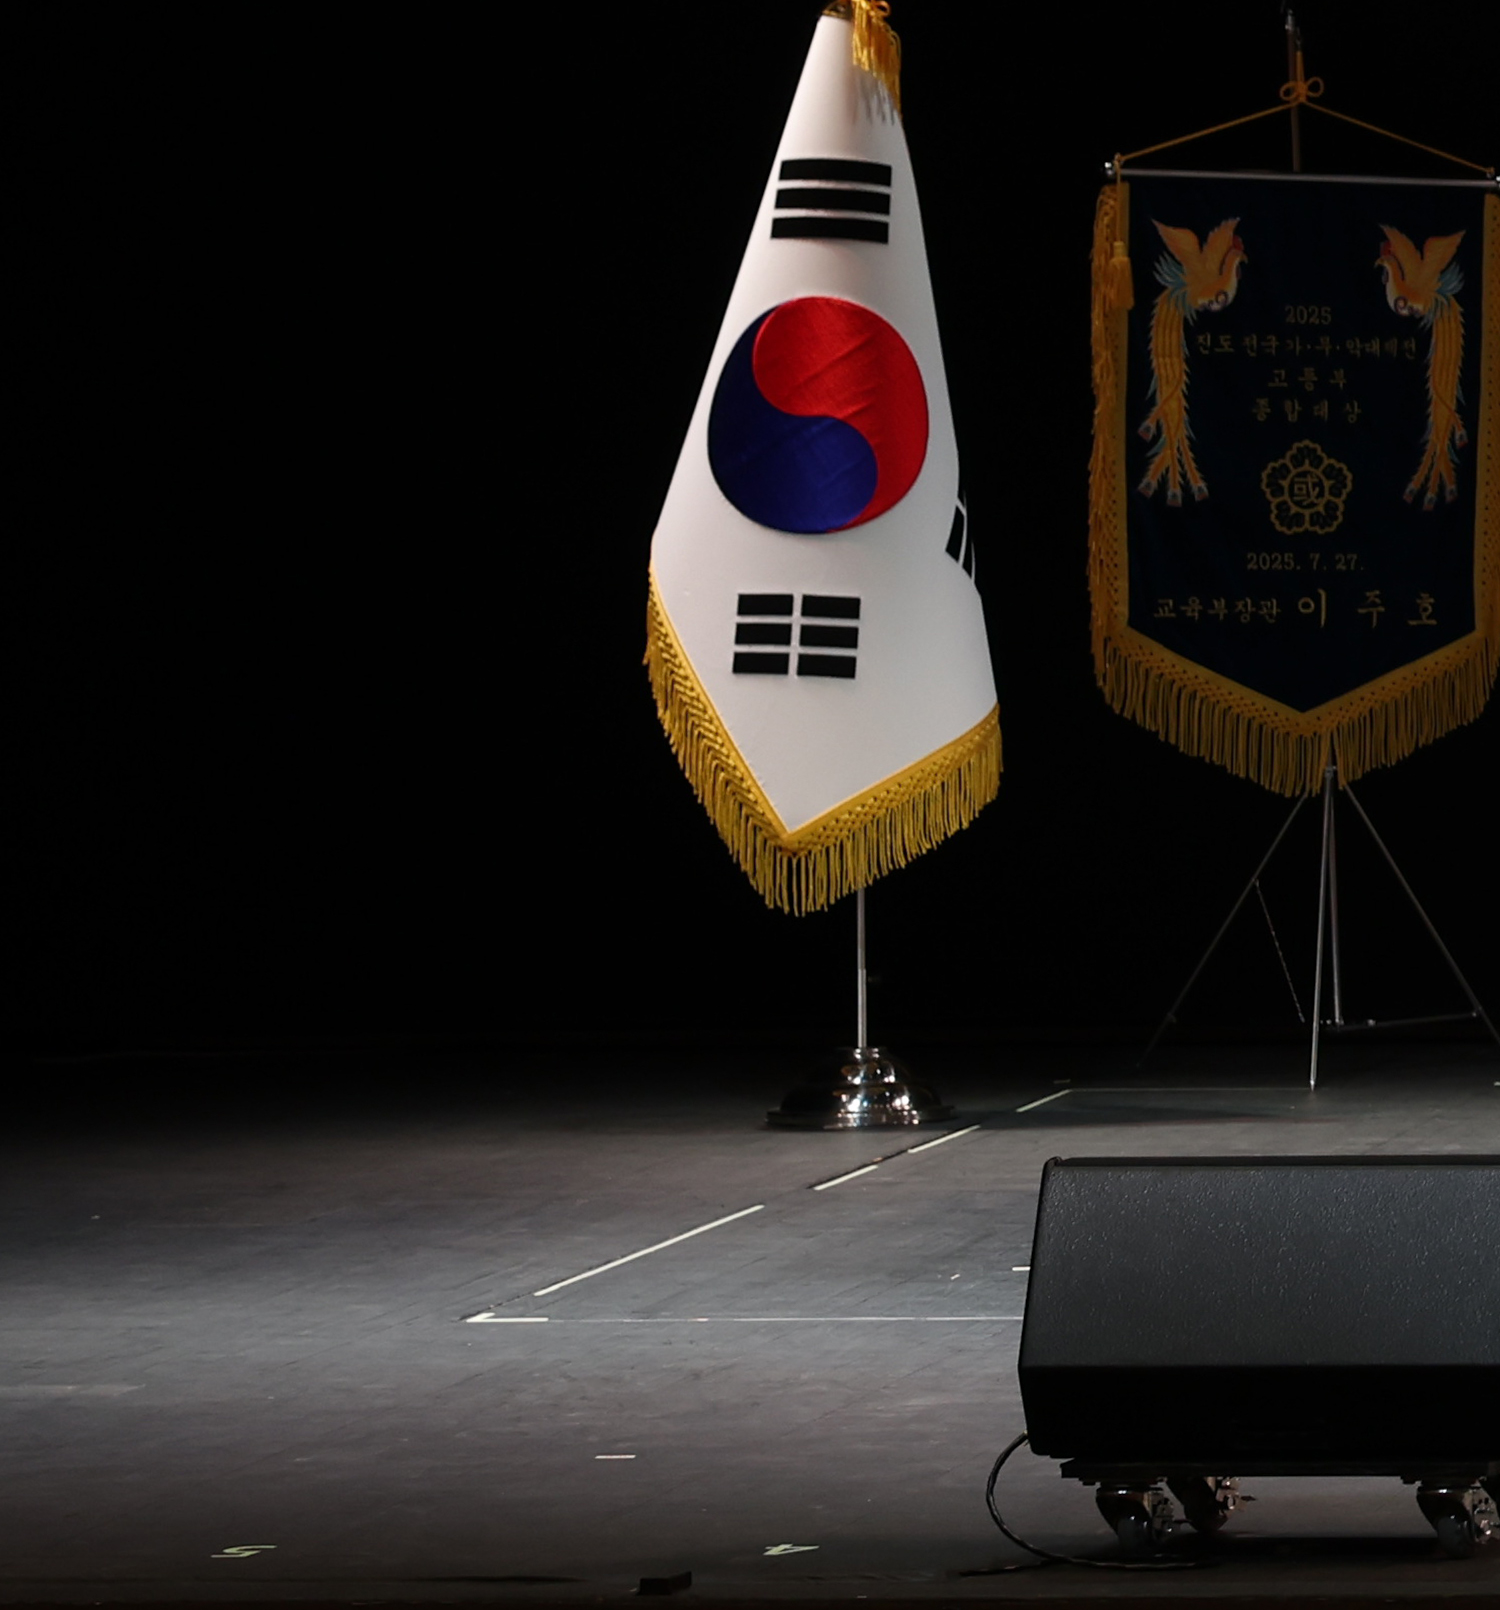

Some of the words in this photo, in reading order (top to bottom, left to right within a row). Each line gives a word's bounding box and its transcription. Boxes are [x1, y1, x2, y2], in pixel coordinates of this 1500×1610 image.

[1284, 305, 1332, 325] 2025
[1196, 332, 1234, 355] 진도
[1242, 333, 1279, 357] 전국
[1246, 551, 1301, 571] 2025.
[1153, 596, 1281, 624] 교육부장관
